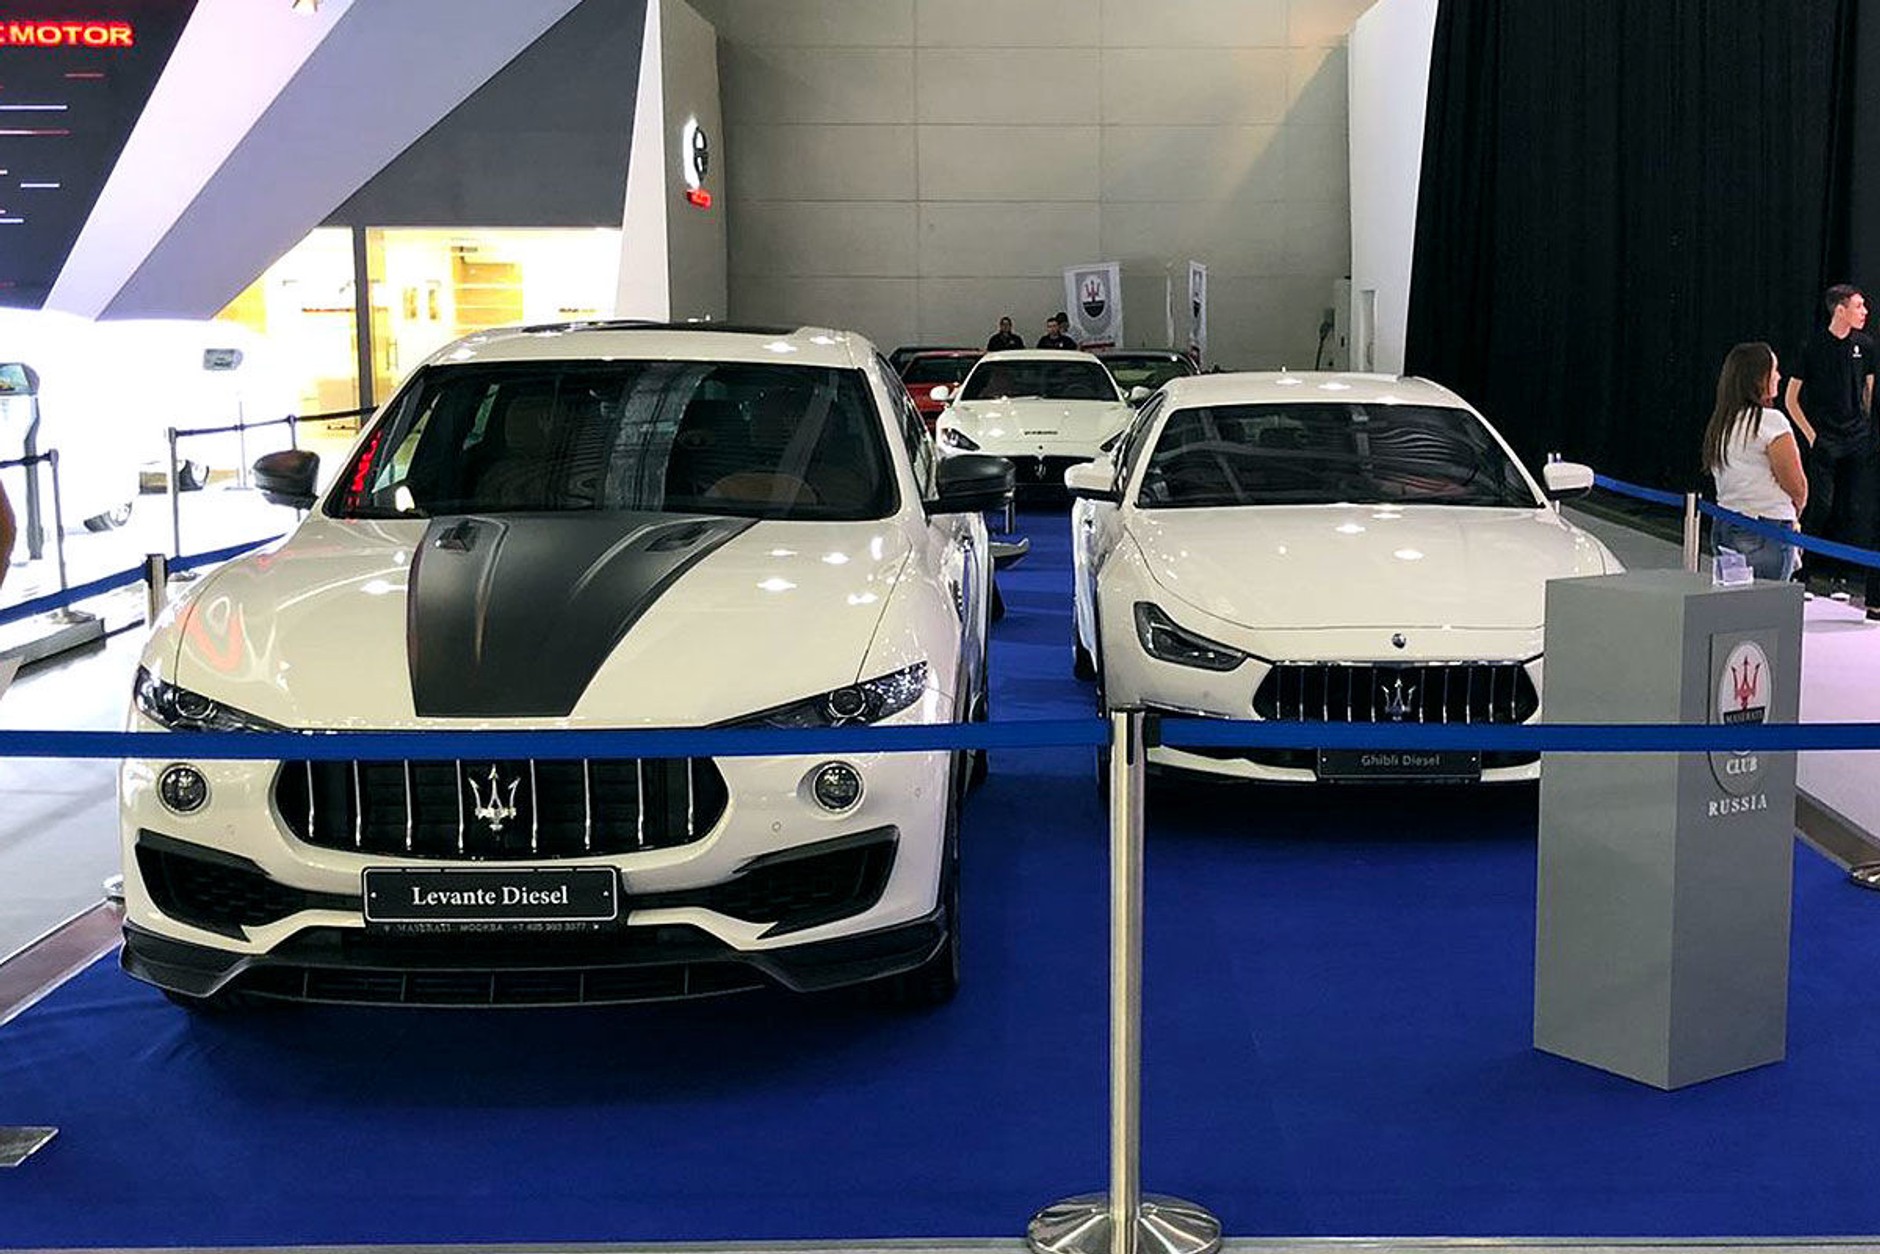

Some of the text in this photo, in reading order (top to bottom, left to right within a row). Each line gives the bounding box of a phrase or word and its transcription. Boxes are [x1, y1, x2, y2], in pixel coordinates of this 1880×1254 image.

[9, 23, 133, 46] MOTOR
[1361, 755, 1440, 767] Ghibli Diesel
[1726, 756, 1758, 775] CLUB
[1708, 794, 1768, 817] RUSSIA
[411, 884, 569, 906] Levante Diesel
